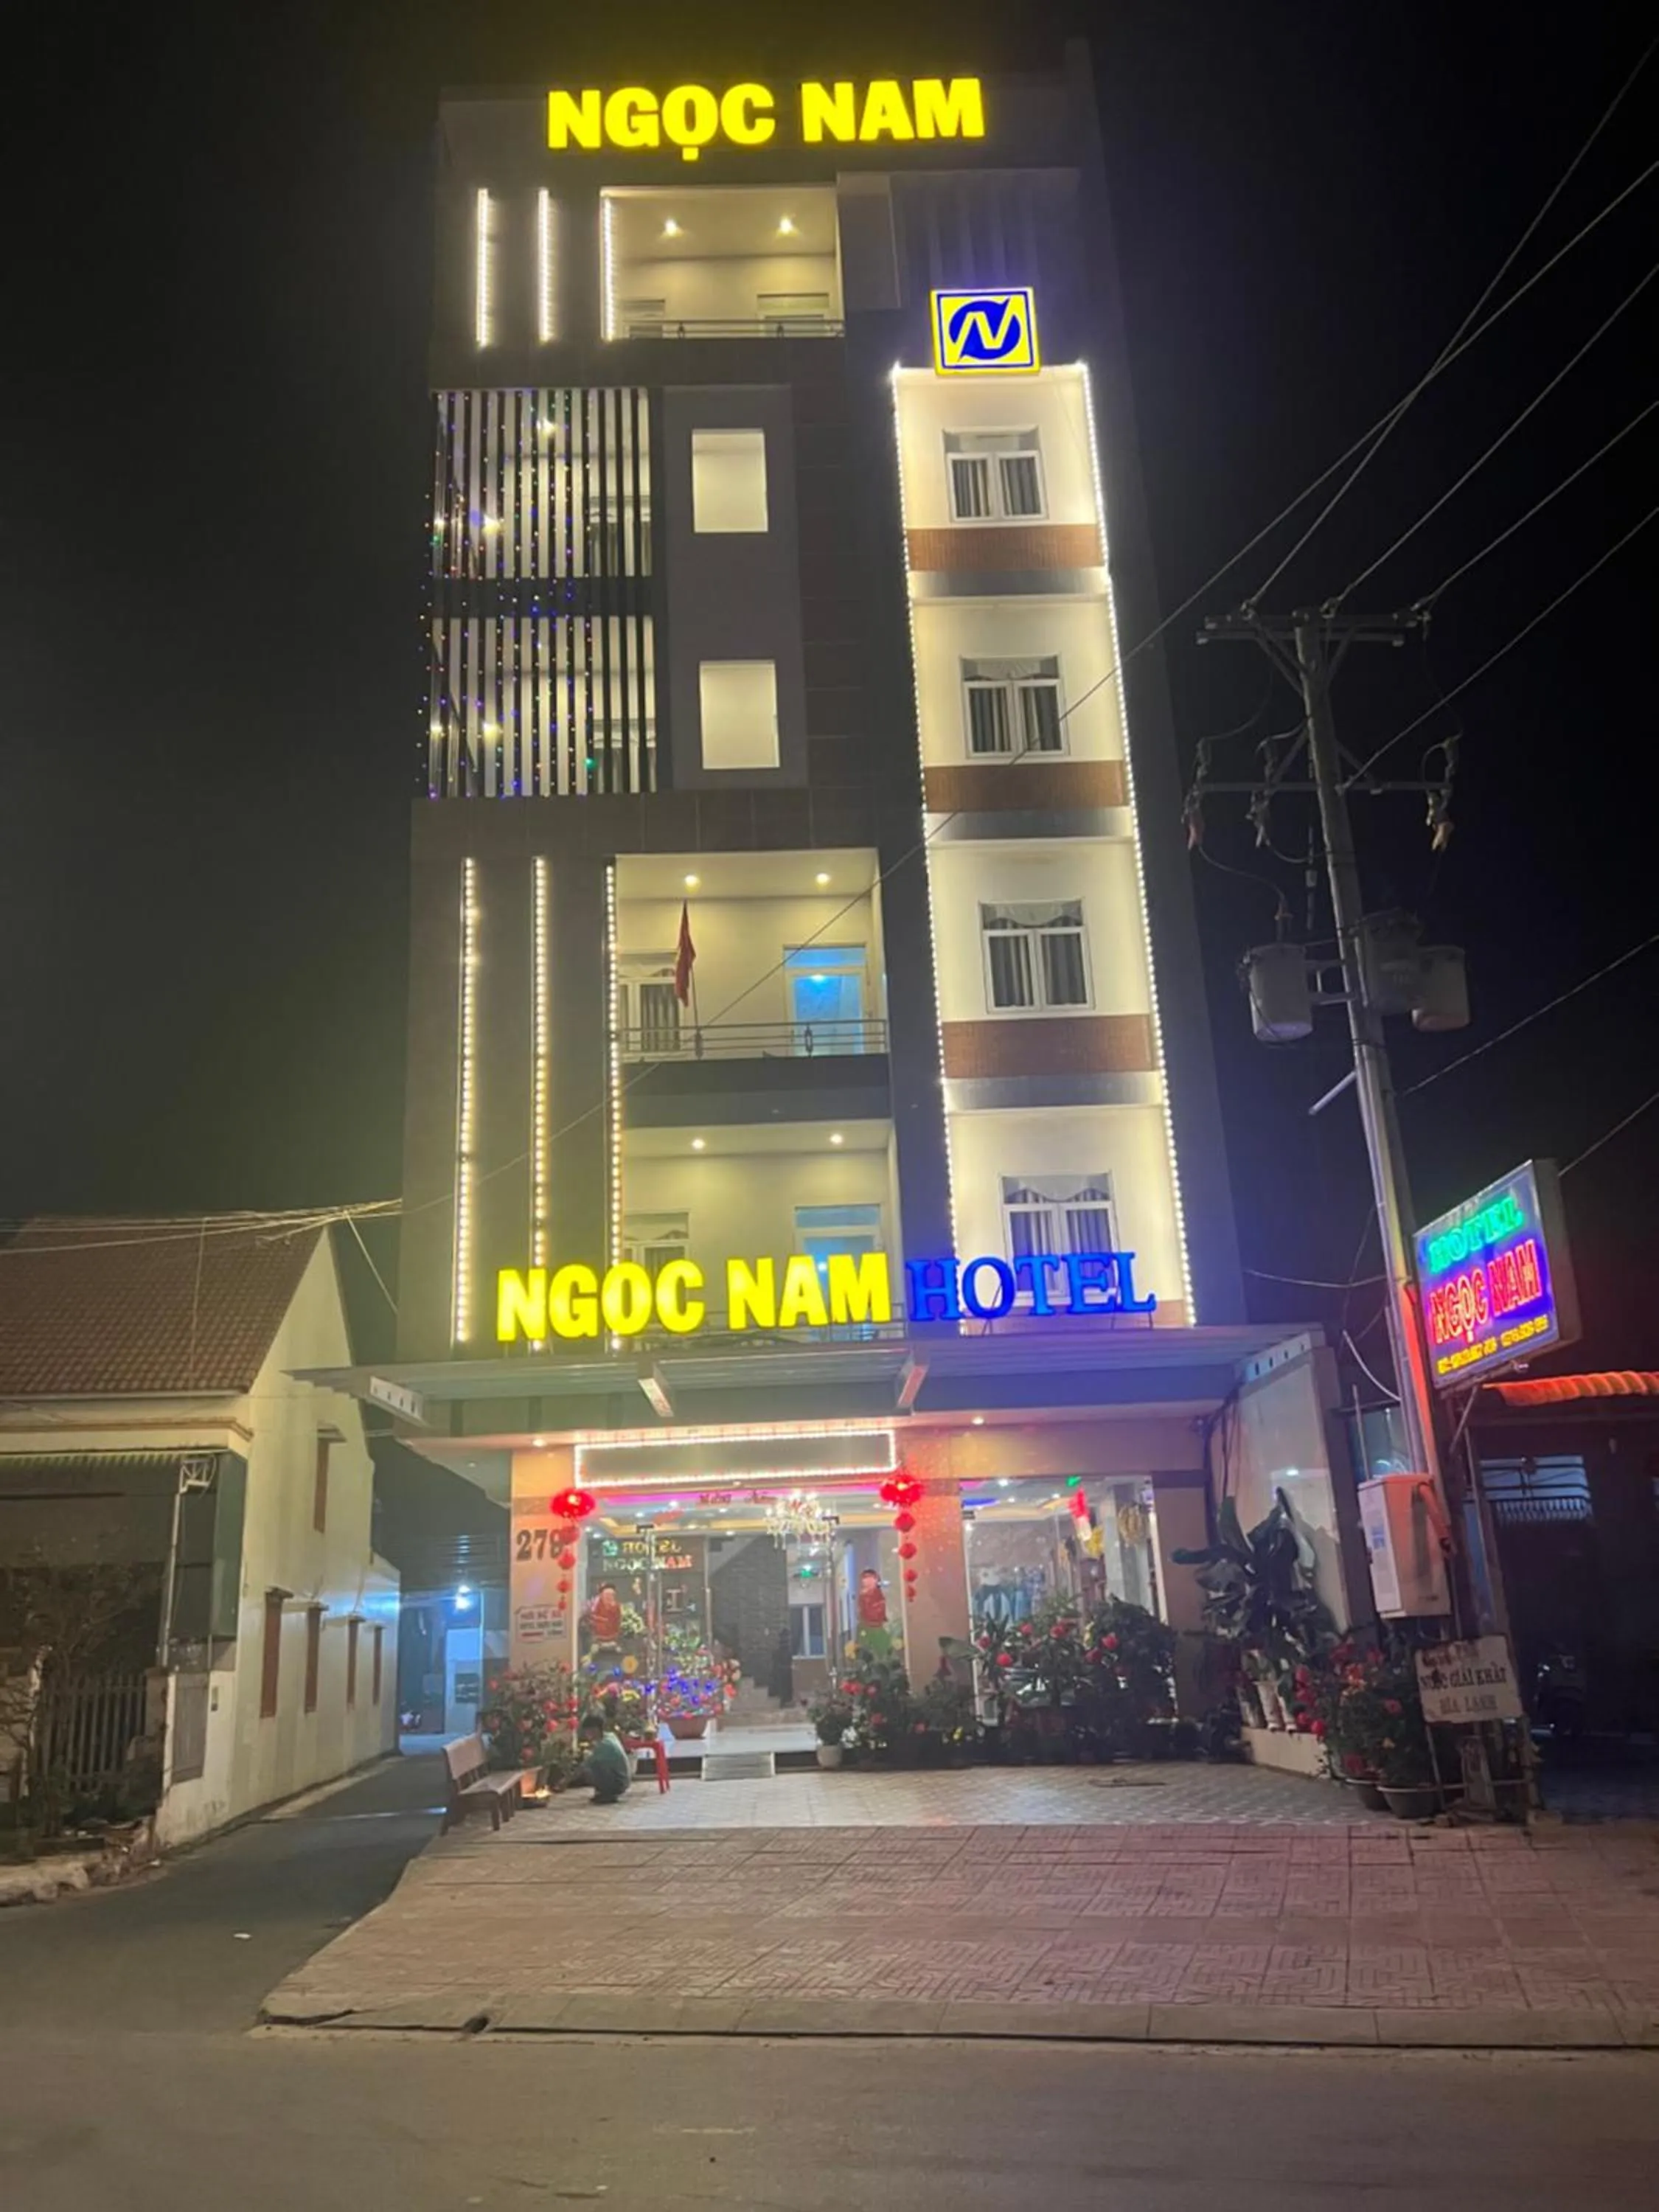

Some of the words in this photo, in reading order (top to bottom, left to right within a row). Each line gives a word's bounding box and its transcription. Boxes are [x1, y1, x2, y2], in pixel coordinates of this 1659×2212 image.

[548, 83, 776, 161] NGỌC
[801, 77, 985, 142] NAM
[1428, 1196, 1523, 1274] HOTEL
[727, 1252, 891, 1330] NAM
[905, 1252, 1157, 1321] HOTEL
[1429, 1268, 1488, 1345] NGỌC
[1487, 1239, 1543, 1317] NAM
